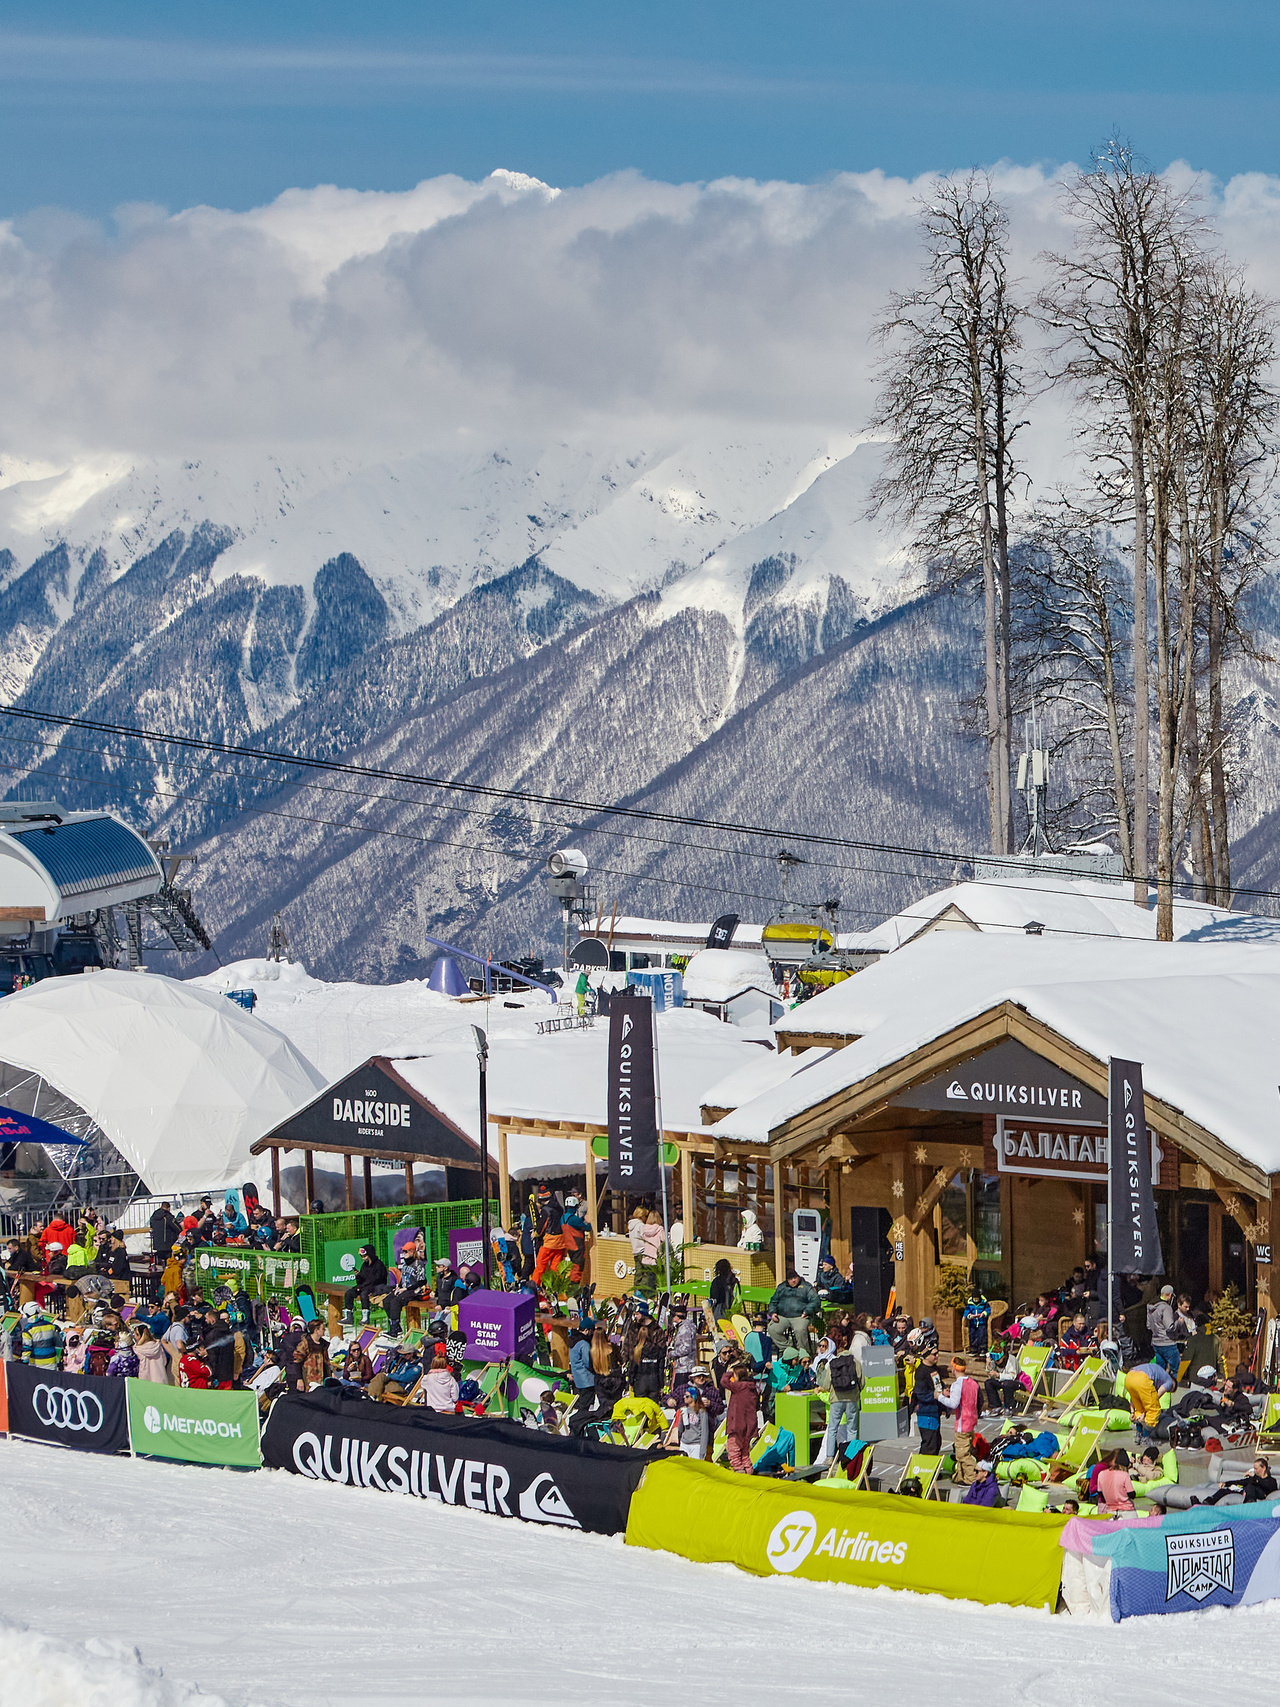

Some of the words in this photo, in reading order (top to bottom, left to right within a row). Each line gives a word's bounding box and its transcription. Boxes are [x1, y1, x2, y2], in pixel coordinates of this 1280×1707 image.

[663, 974, 674, 1009] MELON
[970, 1082, 1083, 1109] QUIKSILVER
[333, 1098, 411, 1128] DARKSIDE
[618, 1044, 634, 1177] QUIKSILVER
[357, 1127, 375, 1136] RIDER'S
[374, 1129, 384, 1137] BAR
[1005, 1130, 1108, 1163] БАЛАГАН
[1125, 1113, 1143, 1258] QUIKSILVER
[1256, 1245, 1271, 1257] WC
[210, 1256, 251, 1271] МЕГАФОН
[332, 1274, 356, 1283] МЕГАФ
[483, 1322, 502, 1331] NEW
[477, 1330, 497, 1339] STAR
[475, 1339, 499, 1347] CAMP
[865, 1385, 890, 1393] FLIGHT
[863, 1397, 894, 1405] SESSION
[163, 1412, 242, 1440] МЕГАФОН
[293, 1431, 513, 1517] QUIKSILVER
[770, 1524, 812, 1557] S7
[814, 1527, 908, 1566] Airlines
[1170, 1535, 1230, 1550] QUIKSILVER
[1189, 1583, 1214, 1593] CAMP
